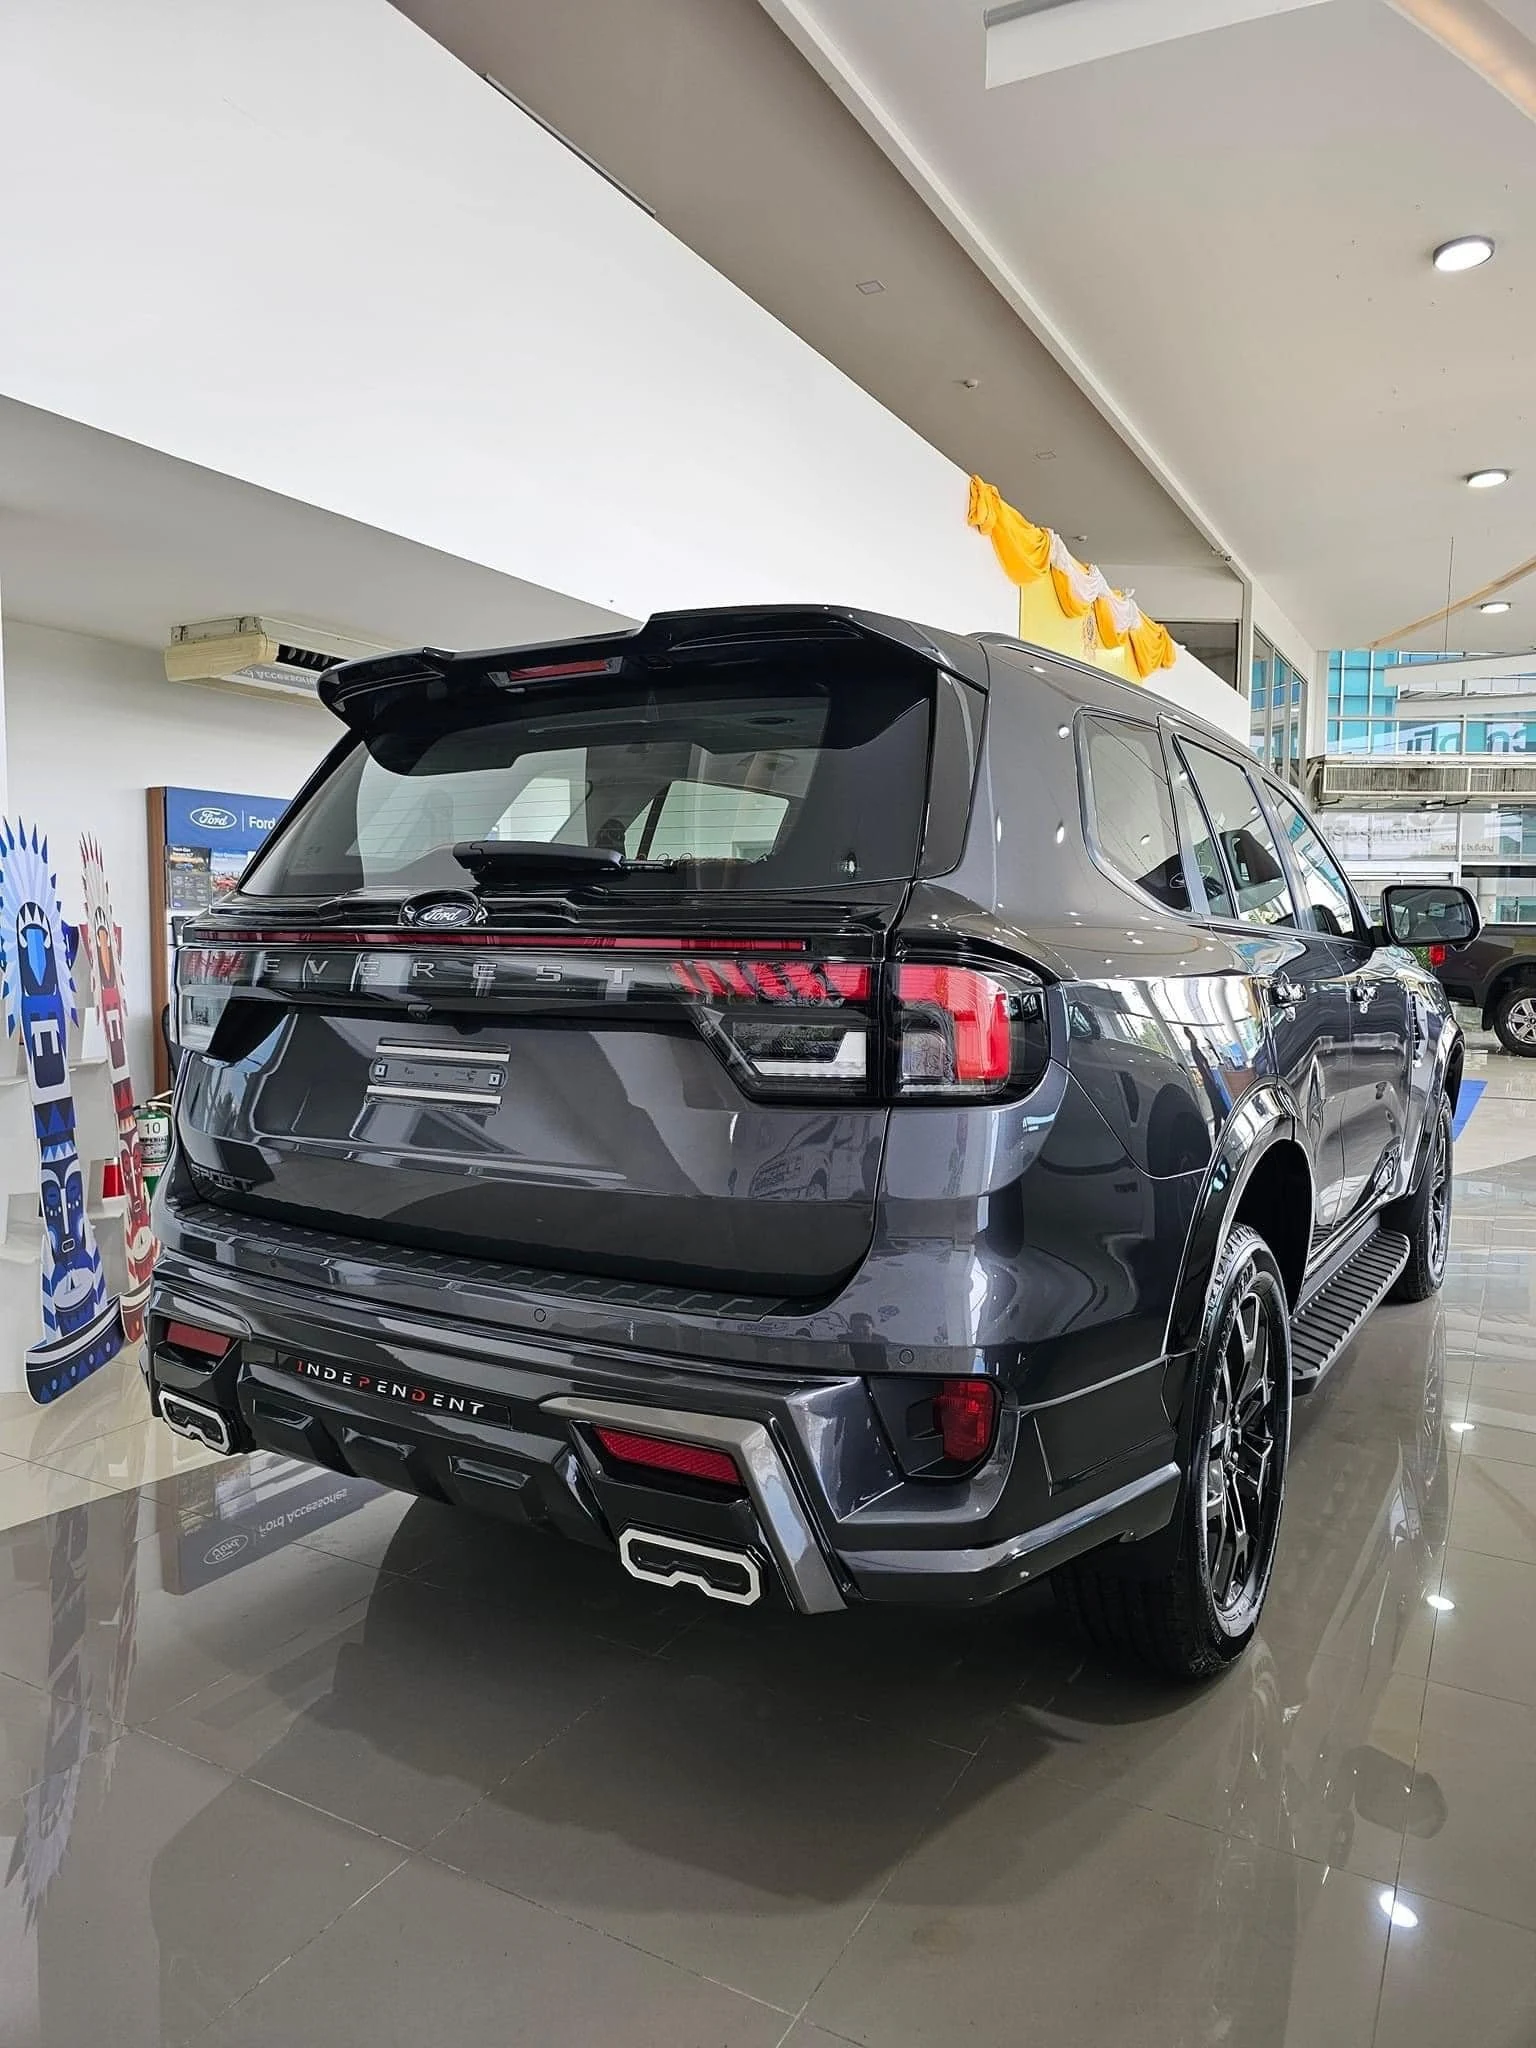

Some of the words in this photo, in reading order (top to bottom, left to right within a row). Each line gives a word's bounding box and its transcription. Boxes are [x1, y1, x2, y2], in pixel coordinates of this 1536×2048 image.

[248, 815, 276, 831] Ford
[421, 905, 459, 922] Ford
[263, 957, 635, 986] EVEREST
[144, 1122, 161, 1135] 10
[190, 1164, 256, 1193] SPORT
[297, 1356, 484, 1415] INDEPENDENT
